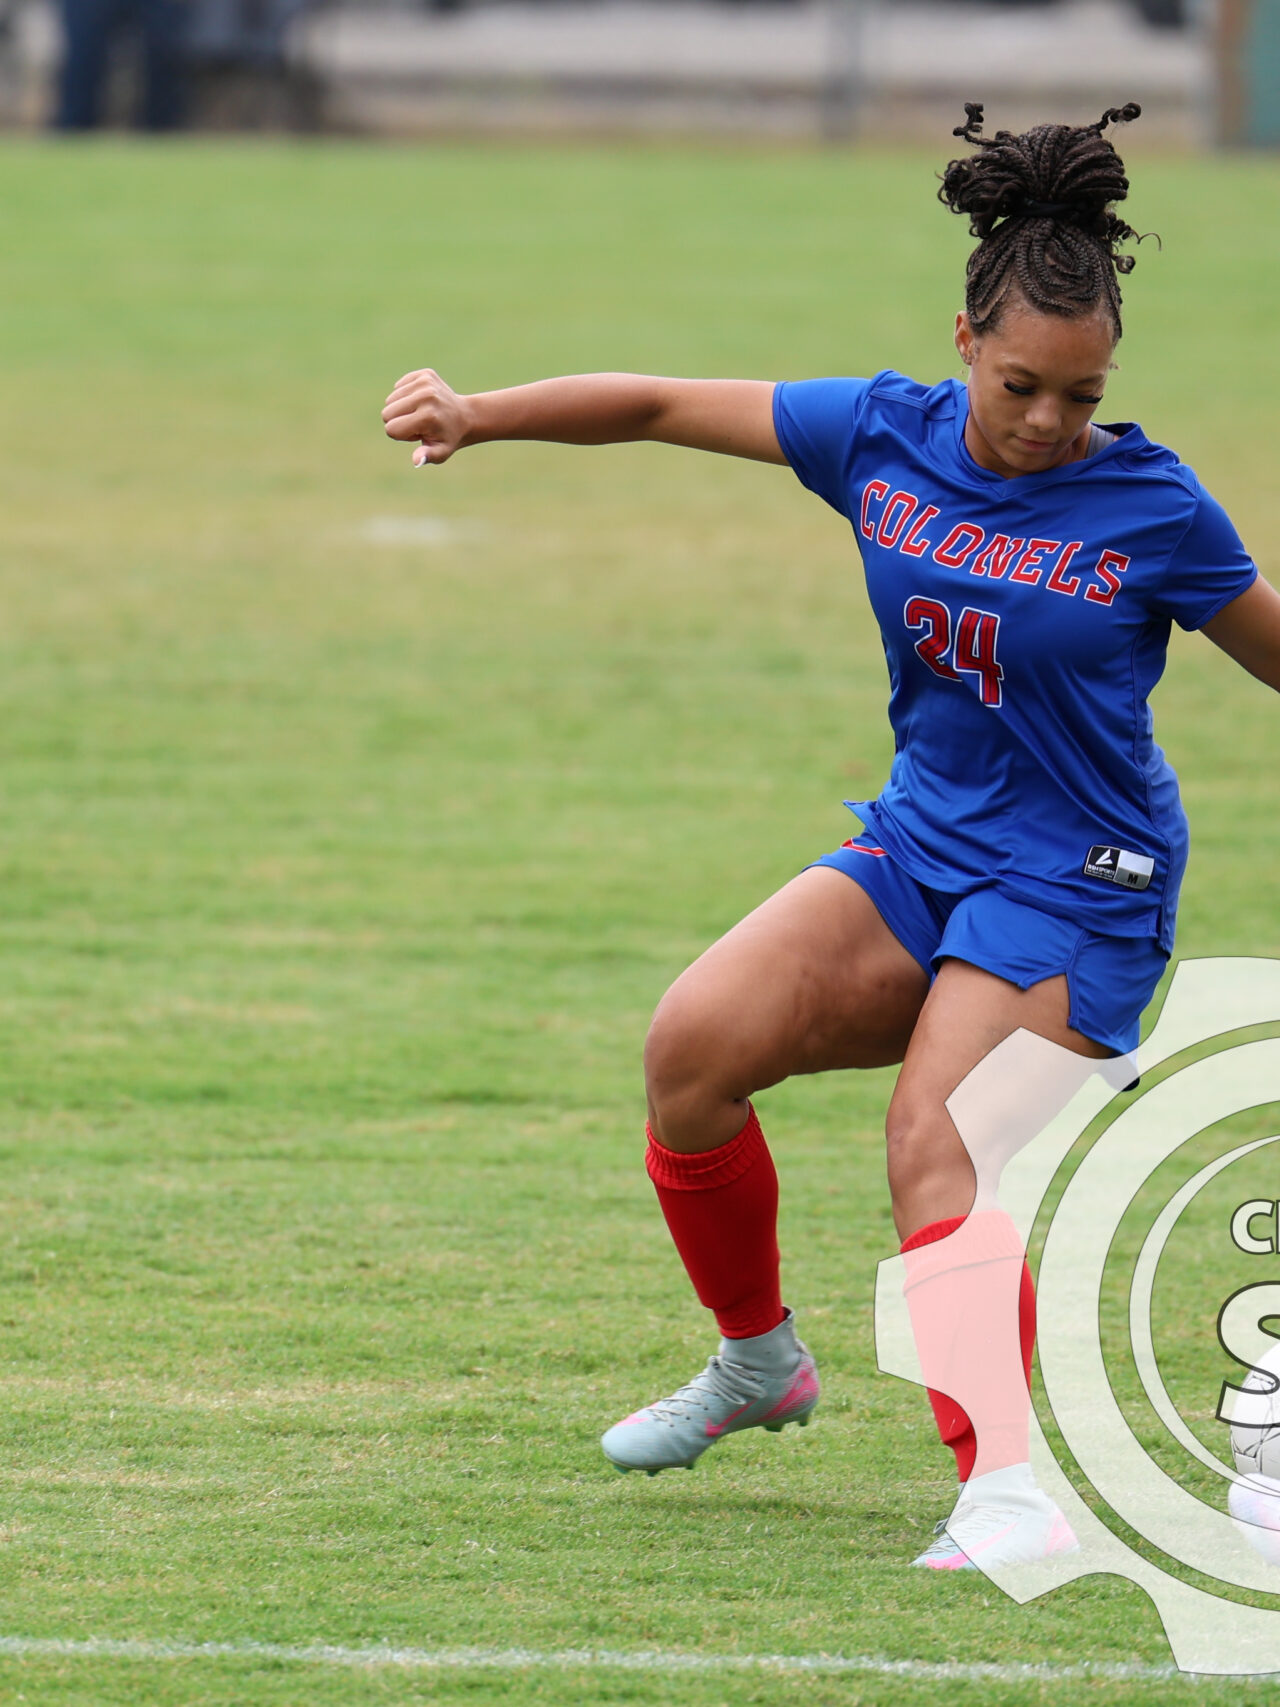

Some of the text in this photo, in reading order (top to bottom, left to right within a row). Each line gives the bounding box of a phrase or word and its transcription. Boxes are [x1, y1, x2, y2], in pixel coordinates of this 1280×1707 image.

[860, 479, 1131, 606] COLONELS
[904, 595, 1004, 708] 24
[1127, 873, 1138, 884] M
